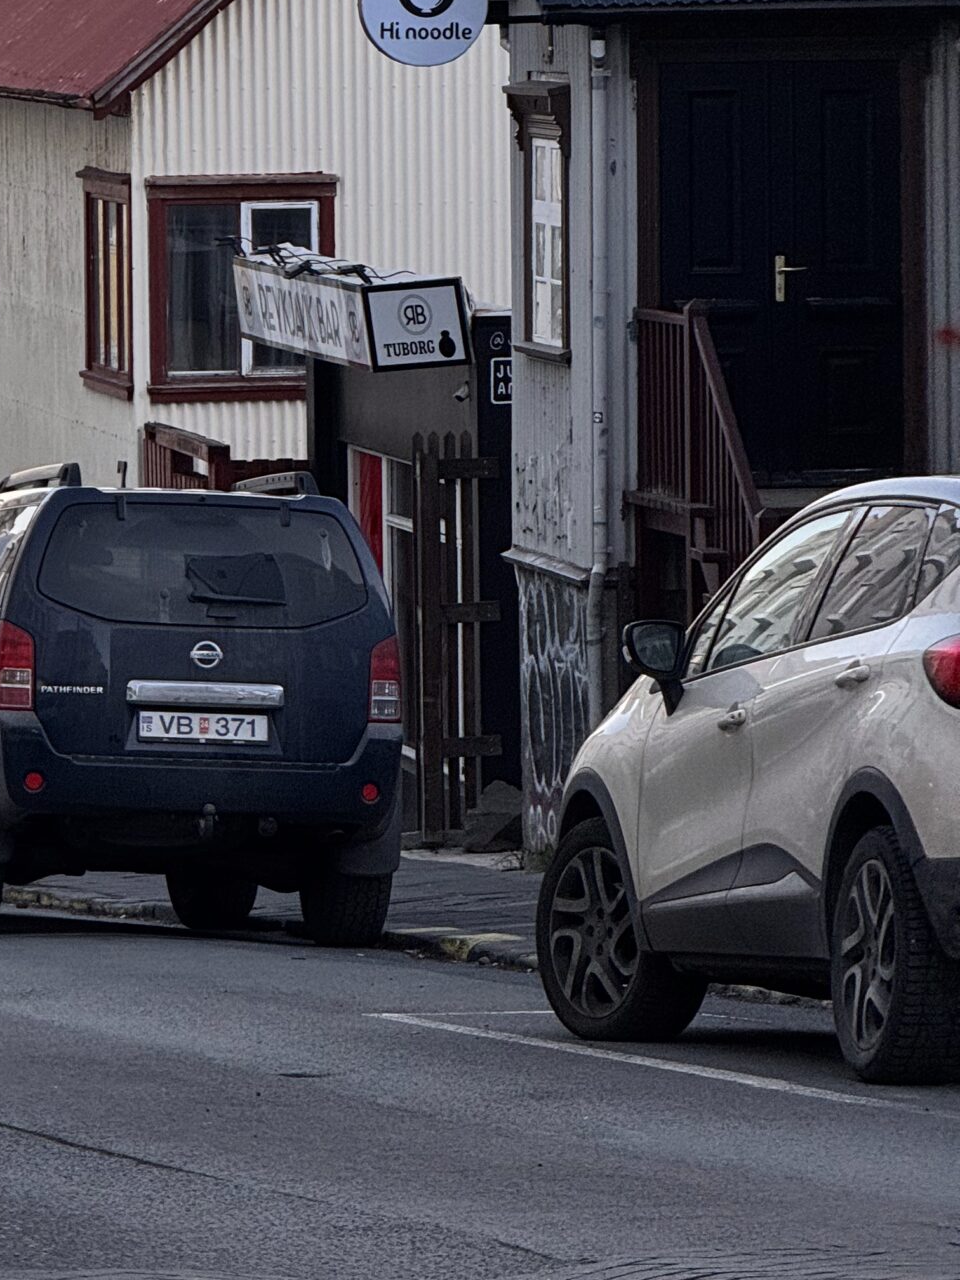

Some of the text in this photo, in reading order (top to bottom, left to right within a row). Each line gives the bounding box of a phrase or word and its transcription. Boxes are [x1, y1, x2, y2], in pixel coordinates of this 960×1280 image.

[380, 22, 473, 40] Hi noodle
[316, 297, 342, 348] BAR
[383, 339, 435, 357] TUBORG
[40, 685, 104, 695] PATHFINDER
[142, 724, 153, 733] IS
[159, 715, 256, 738] VB 371
